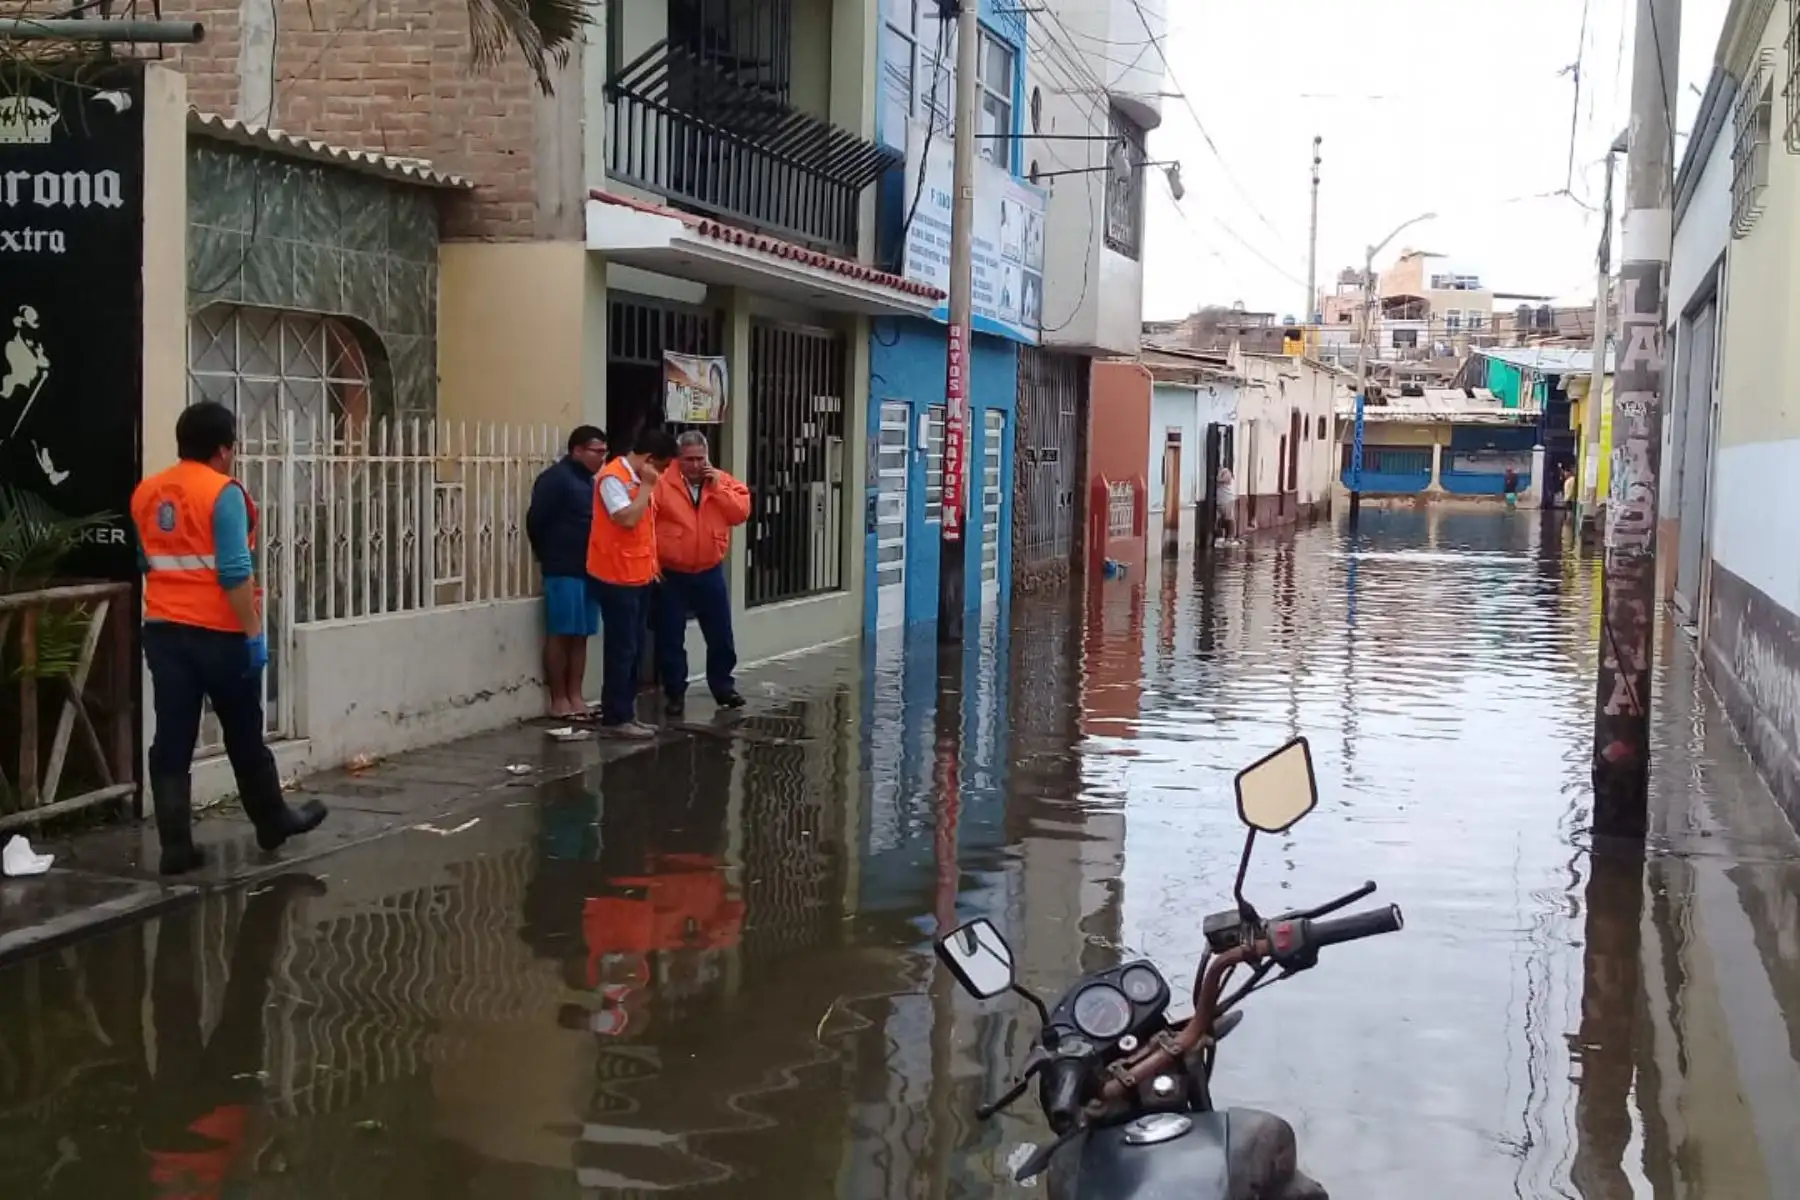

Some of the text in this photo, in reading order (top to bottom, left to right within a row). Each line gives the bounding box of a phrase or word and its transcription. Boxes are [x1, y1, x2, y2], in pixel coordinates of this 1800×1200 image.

[0, 168, 124, 208] rona
[948, 325, 961, 391] RAYOS
[944, 432, 959, 499] RAYOS
